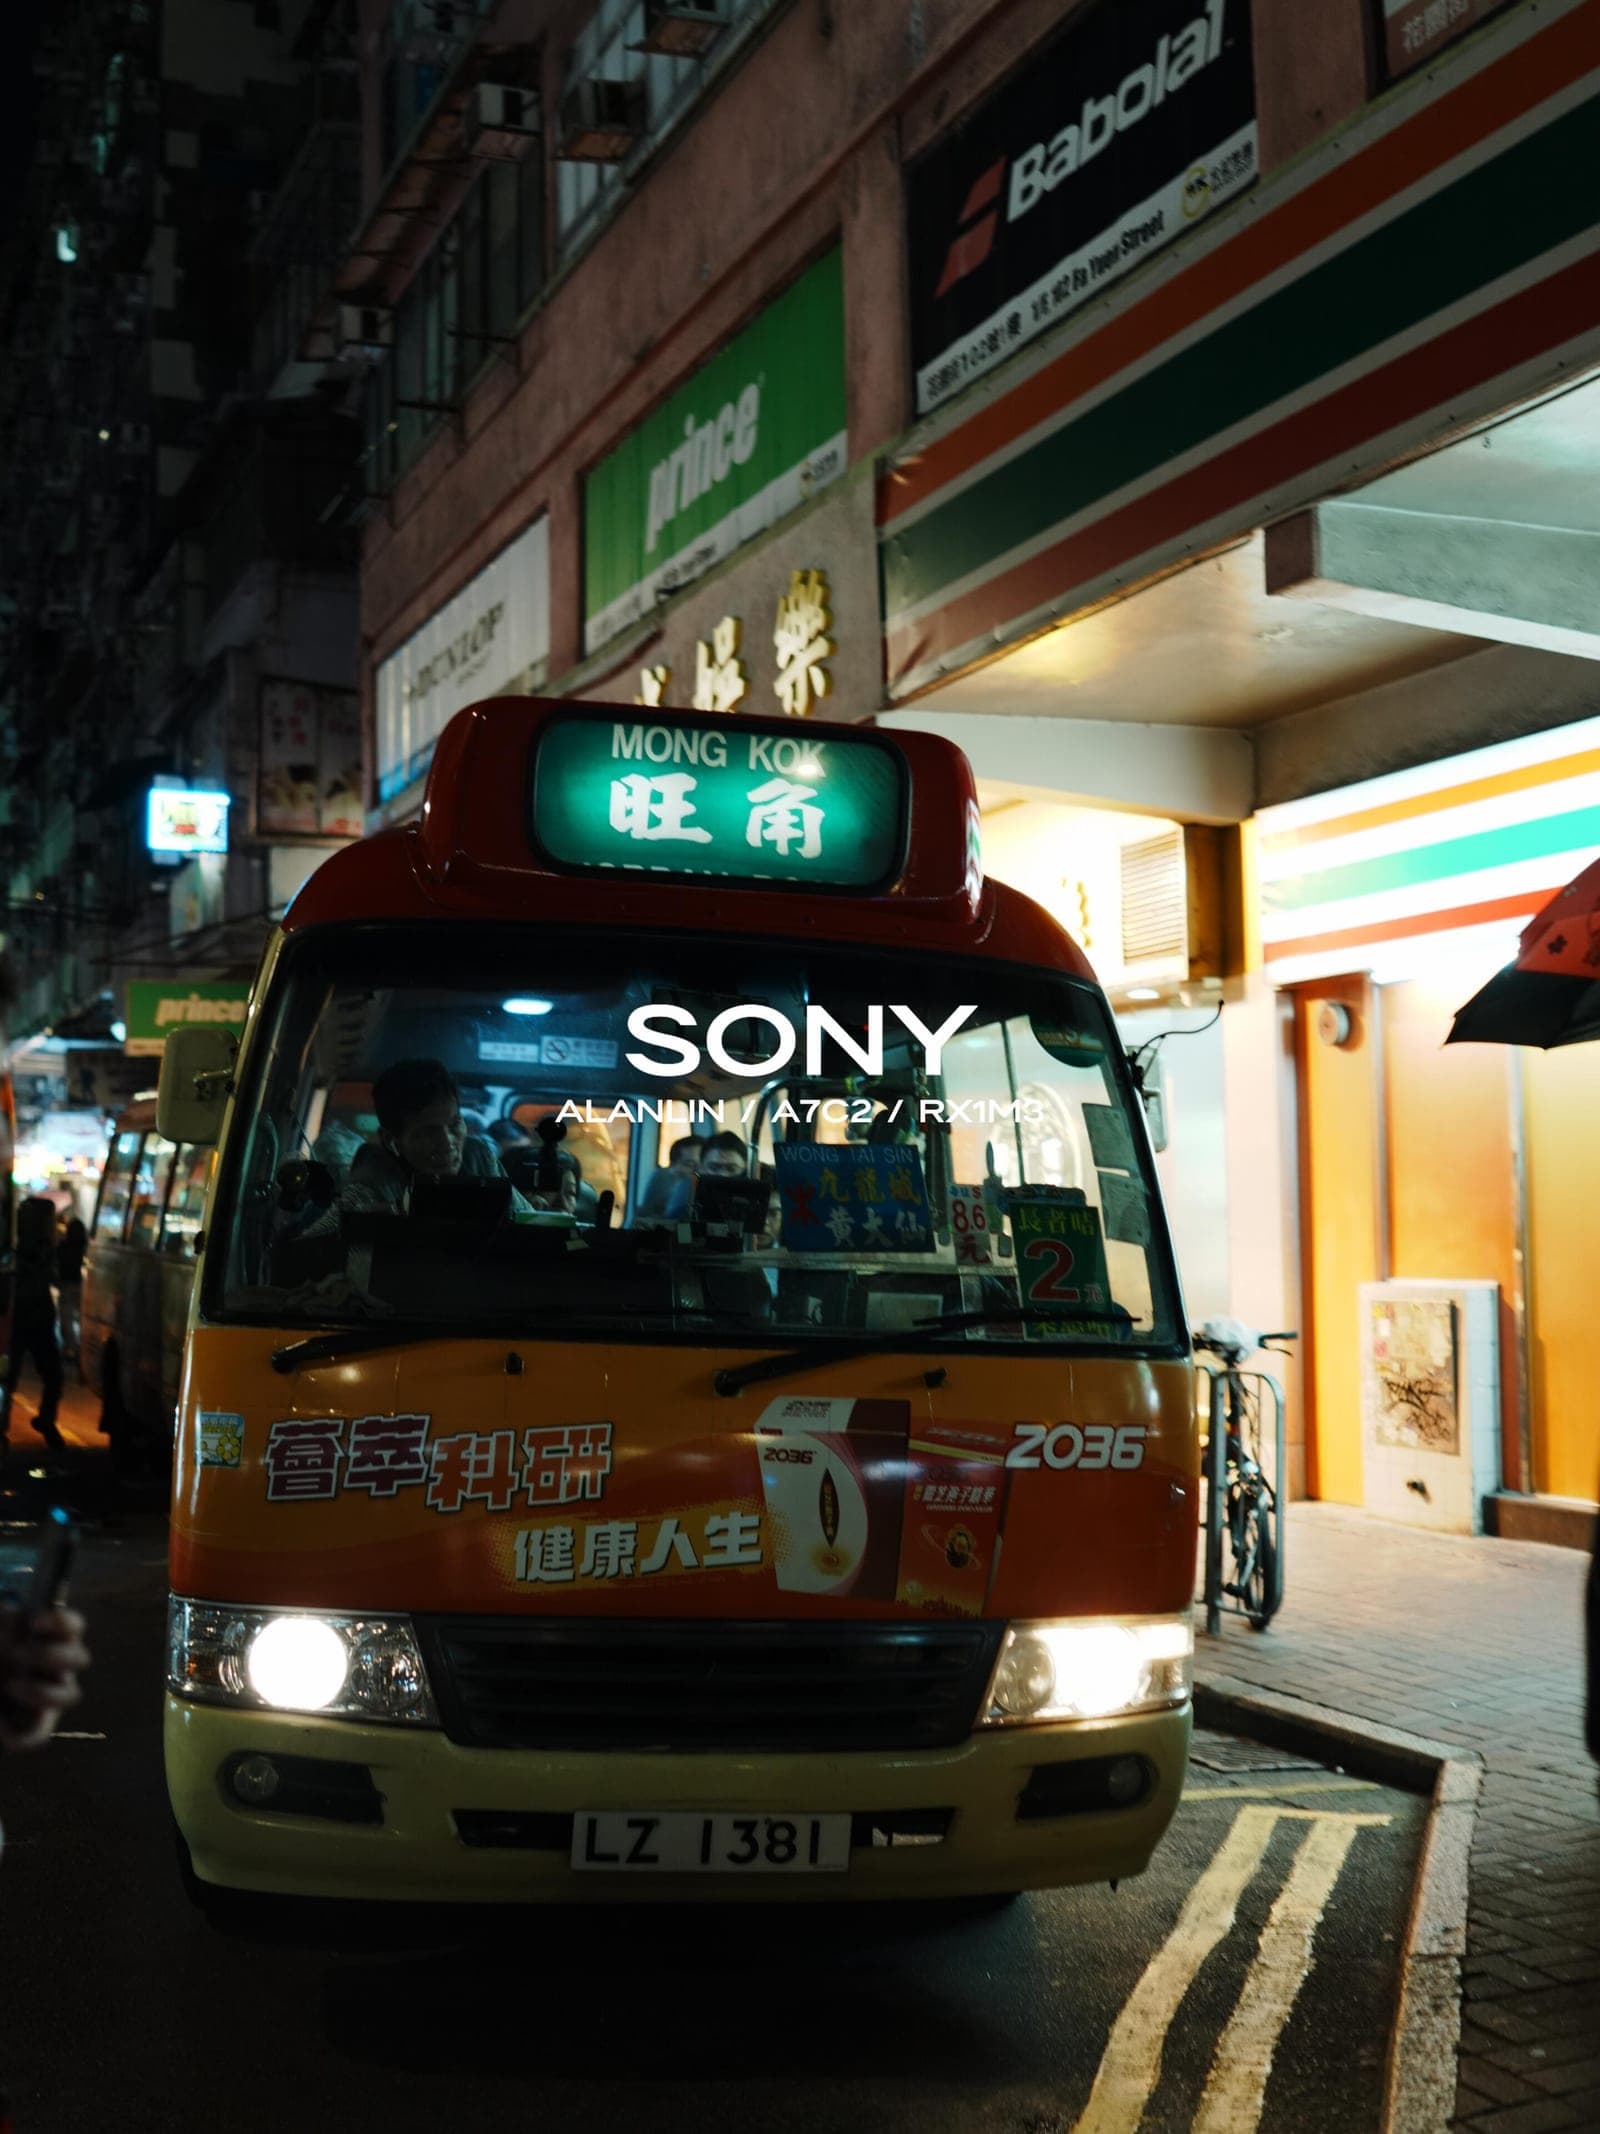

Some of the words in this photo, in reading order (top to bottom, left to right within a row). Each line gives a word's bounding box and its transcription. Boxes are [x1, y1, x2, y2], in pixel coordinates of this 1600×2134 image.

[1006, 0, 1226, 223] Babolat
[645, 382, 761, 556] prince
[611, 723, 728, 768] MONG
[748, 735, 827, 778] KOK
[609, 772, 827, 860] 旺角
[779, 1146, 840, 1164] WONG
[850, 1149, 876, 1164] TAI
[883, 1150, 913, 1165] SIN
[952, 1199, 986, 1233] 8.6
[1023, 1237, 1081, 1304] 2
[266, 1412, 614, 1513] 薈萃科研
[763, 1447, 814, 1465] 2036
[1005, 1422, 1147, 1471] 2036
[513, 1510, 763, 1583] 健康人生
[584, 1816, 661, 1865] LZ
[699, 1817, 821, 1866] 1381
